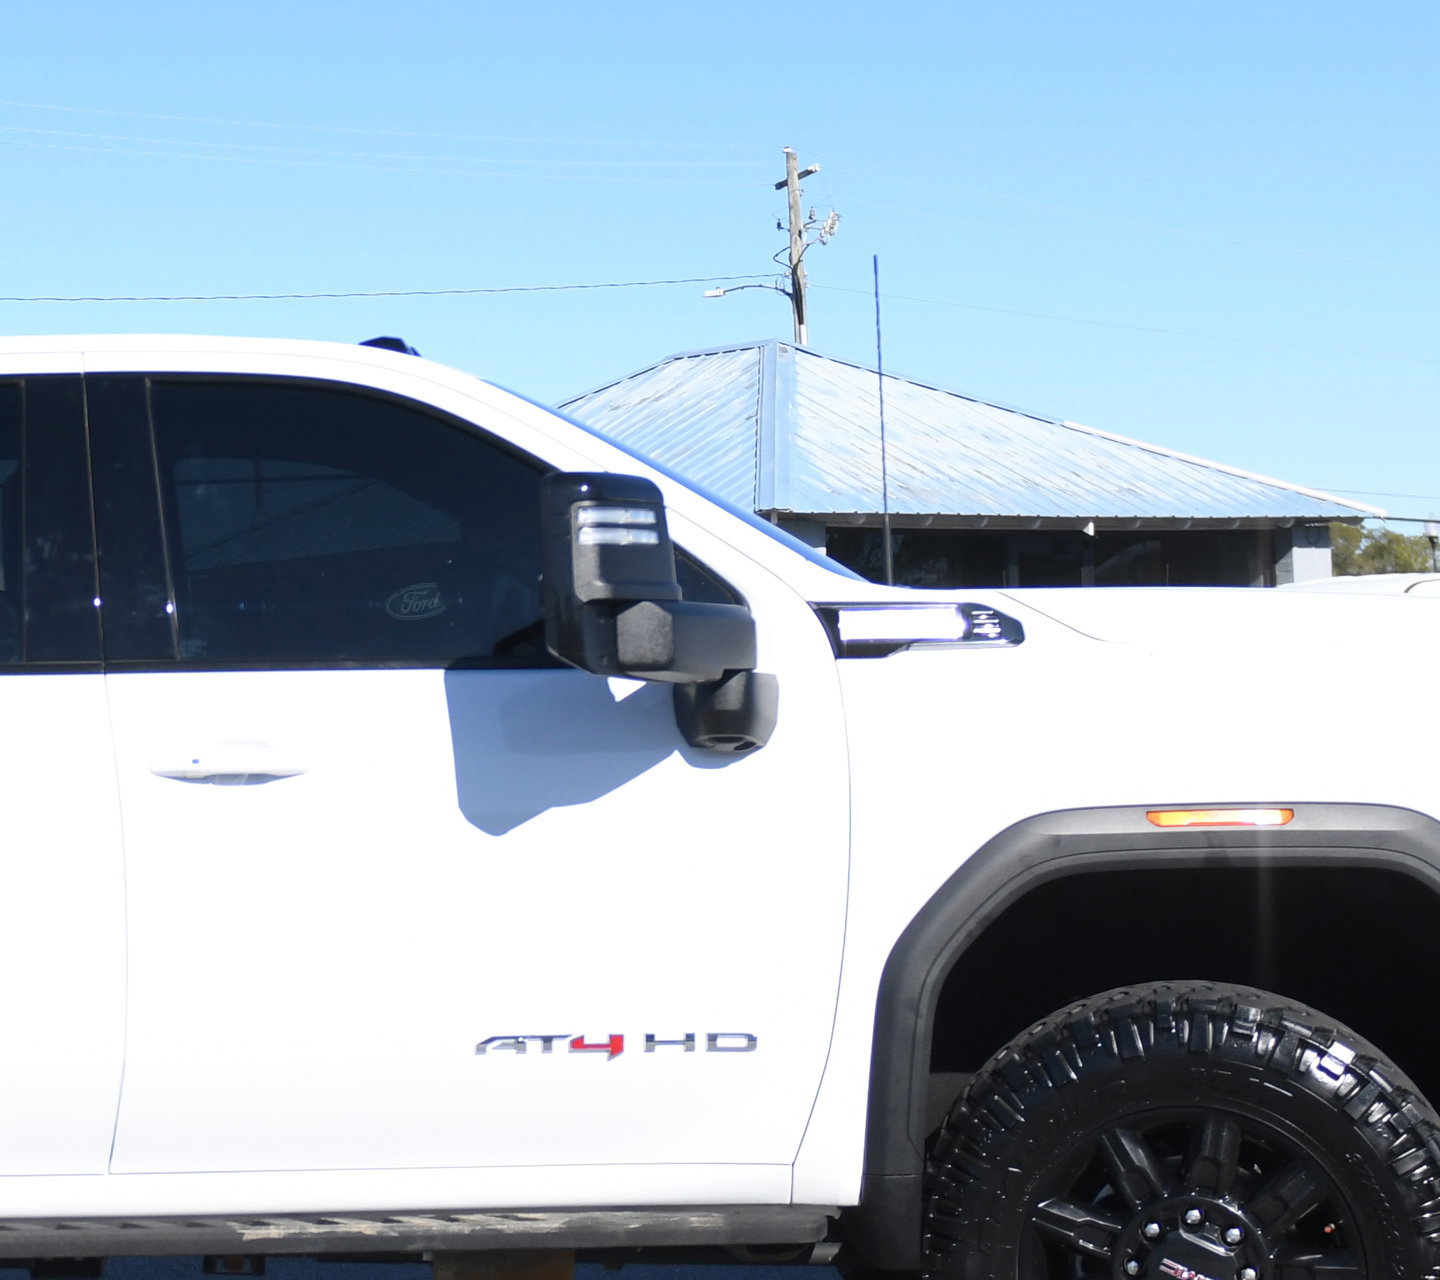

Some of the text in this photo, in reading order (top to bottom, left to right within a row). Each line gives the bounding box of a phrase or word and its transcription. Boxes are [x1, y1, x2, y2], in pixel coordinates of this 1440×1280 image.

[400, 590, 441, 614] Ford
[474, 1032, 758, 1062] AT4 HD
